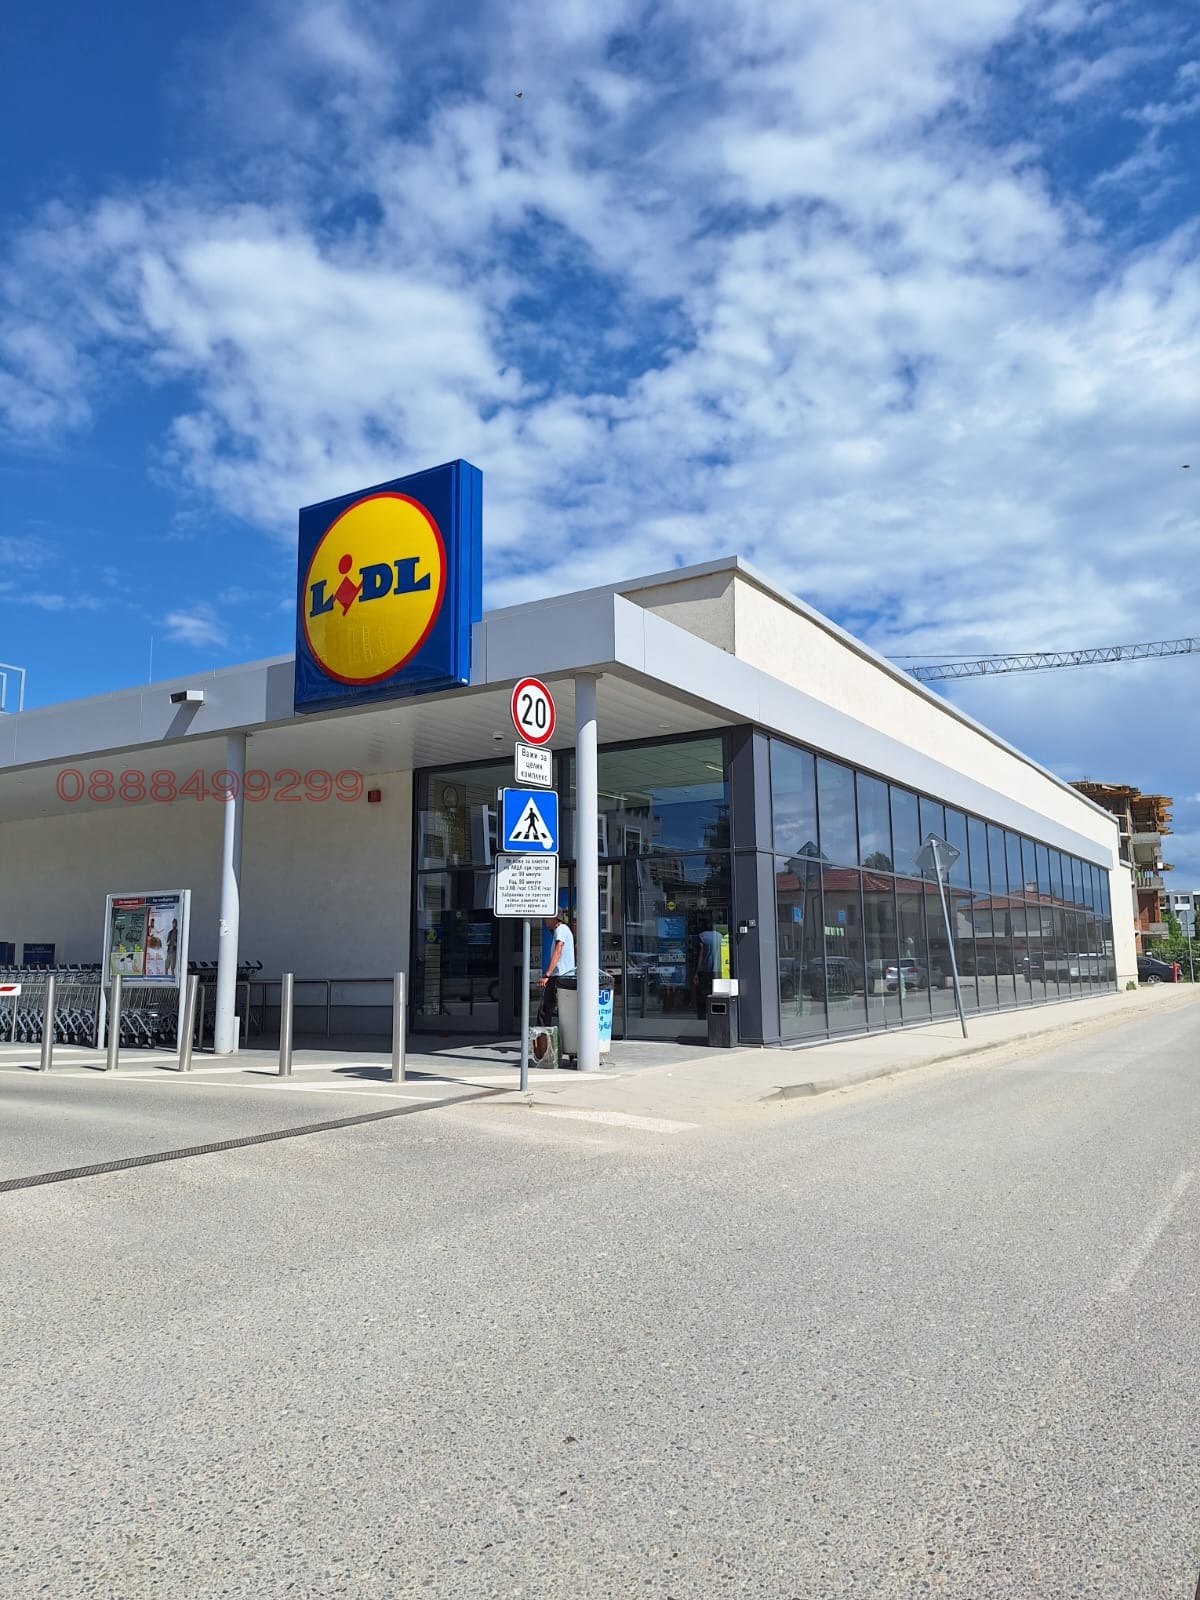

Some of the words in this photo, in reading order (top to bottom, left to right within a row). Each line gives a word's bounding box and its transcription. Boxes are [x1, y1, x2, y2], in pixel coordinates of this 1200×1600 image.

[522, 693, 546, 728] 20
[521, 748, 538, 759] Важи
[520, 771, 548, 782] комплекс
